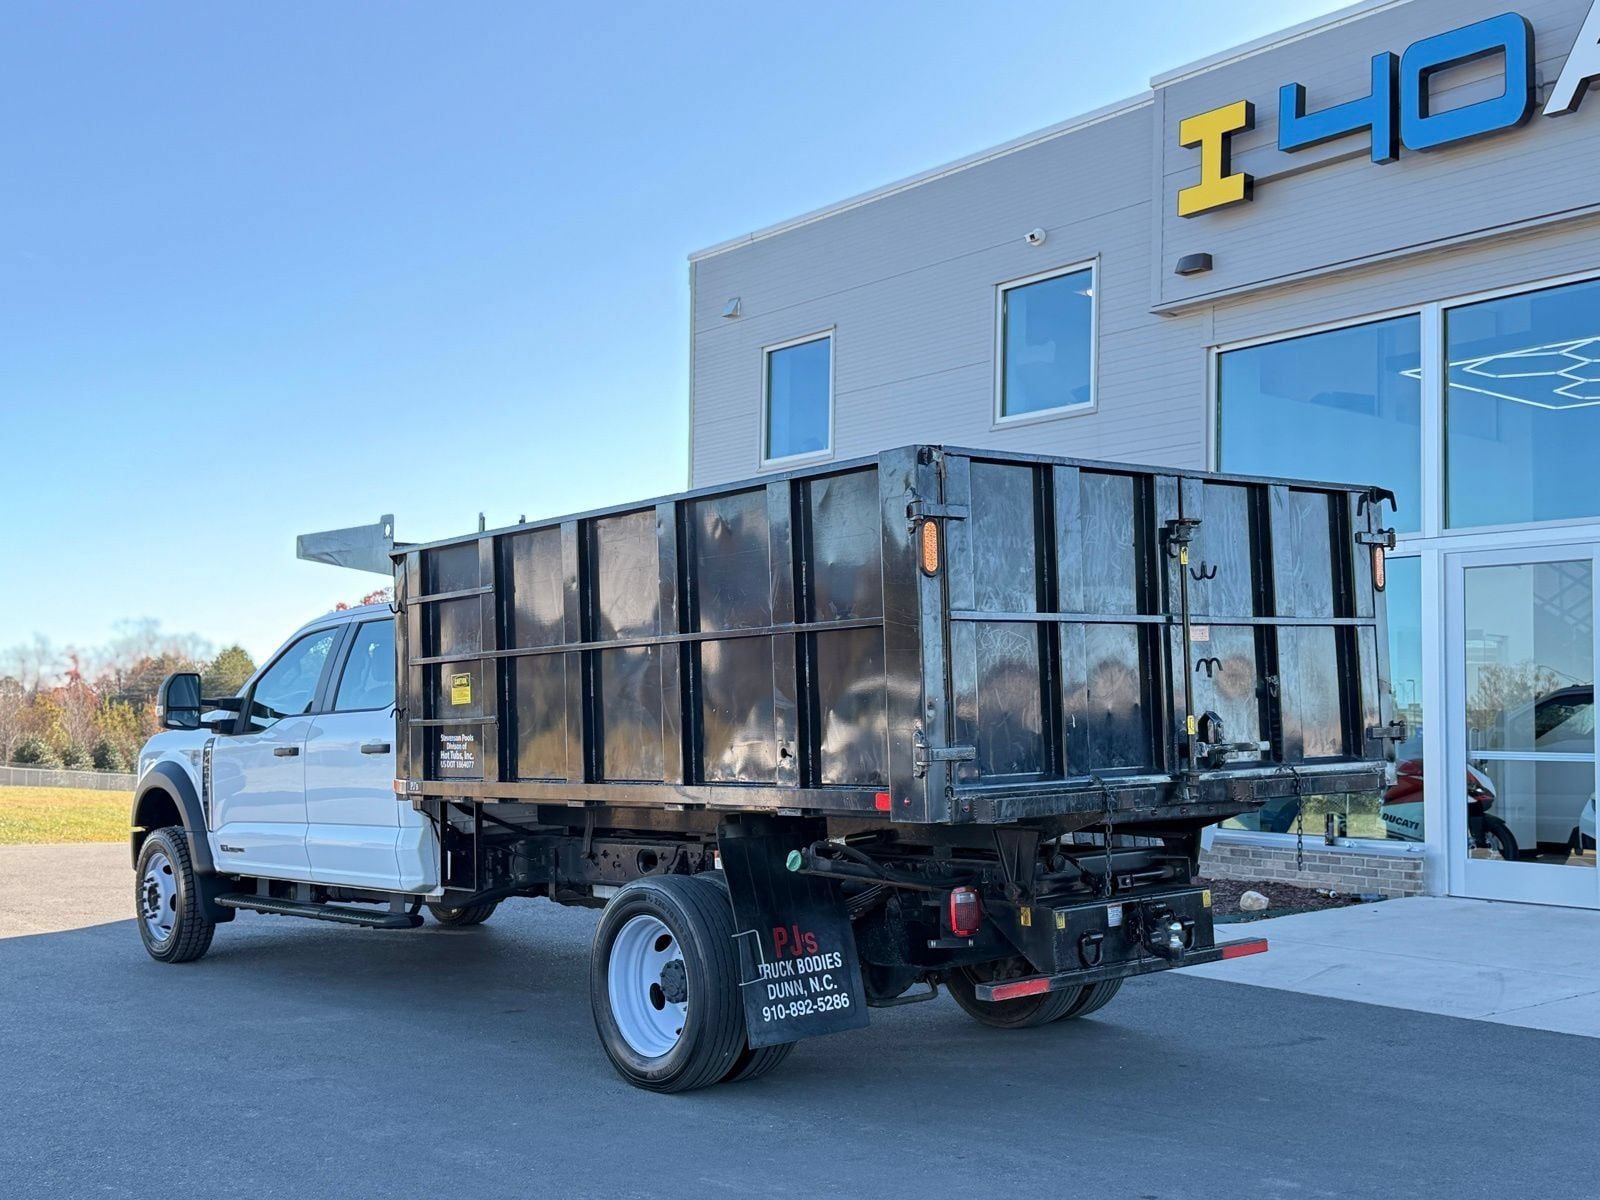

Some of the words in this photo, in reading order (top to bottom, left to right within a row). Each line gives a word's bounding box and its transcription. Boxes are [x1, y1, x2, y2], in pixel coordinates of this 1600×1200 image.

[440, 750, 450, 760] Hot
[450, 750, 463, 761] Tubs,
[464, 750, 474, 760] Inc.
[1381, 813, 1420, 830] DUCATI
[796, 952, 842, 974] BODIES
[767, 979, 808, 1000] DUNN,
[809, 974, 838, 993] N.C.
[762, 992, 850, 1022] 910-892-5286
